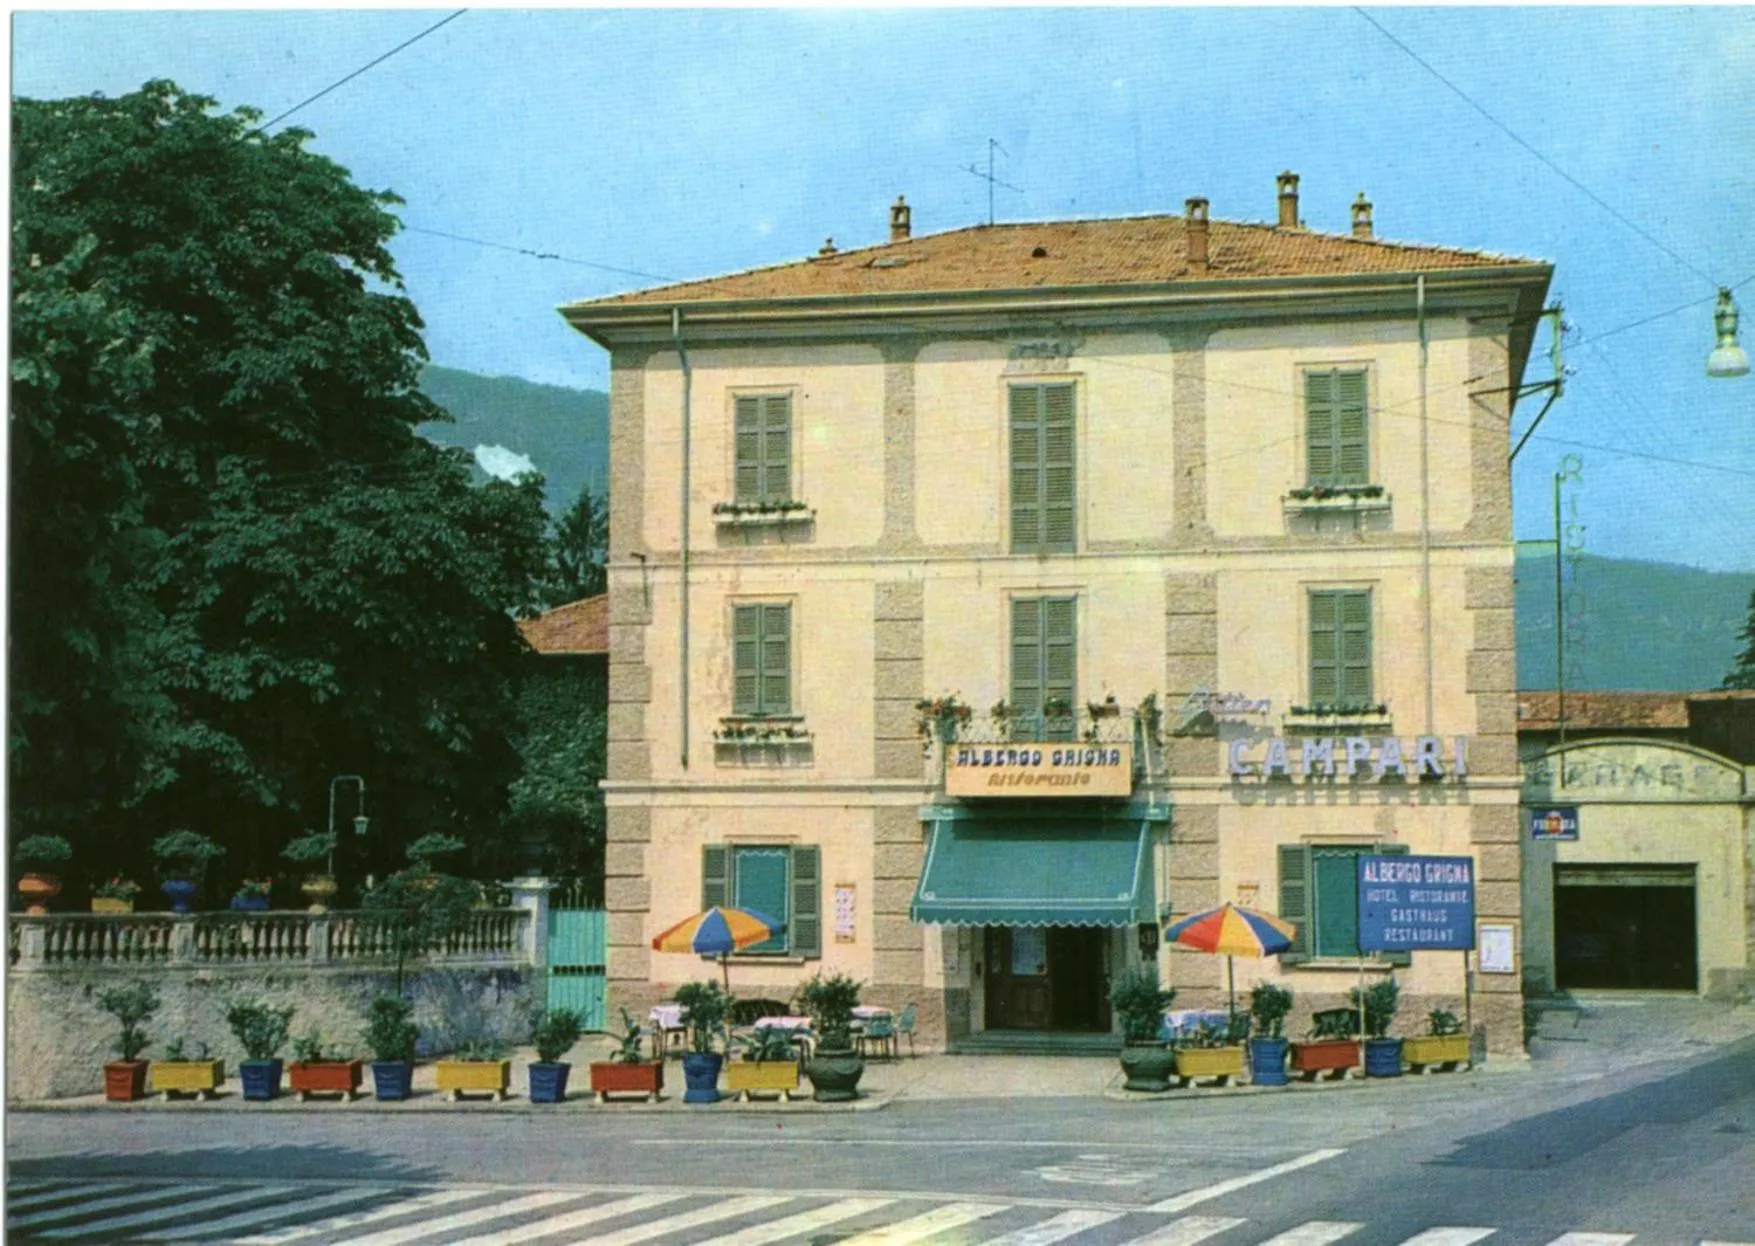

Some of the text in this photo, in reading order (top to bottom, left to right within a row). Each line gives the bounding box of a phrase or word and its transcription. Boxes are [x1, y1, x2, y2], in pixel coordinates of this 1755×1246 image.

[956, 749, 1121, 766] ALBERGO GRIGNA
[1229, 736, 1468, 775] CAMPARI
[1363, 861, 1470, 884] ALBERGO GRIGNA
[1366, 888, 1399, 903] HOTEL
[1390, 908, 1448, 923] GASTHAUS
[1384, 928, 1454, 942] RESTAURANT
